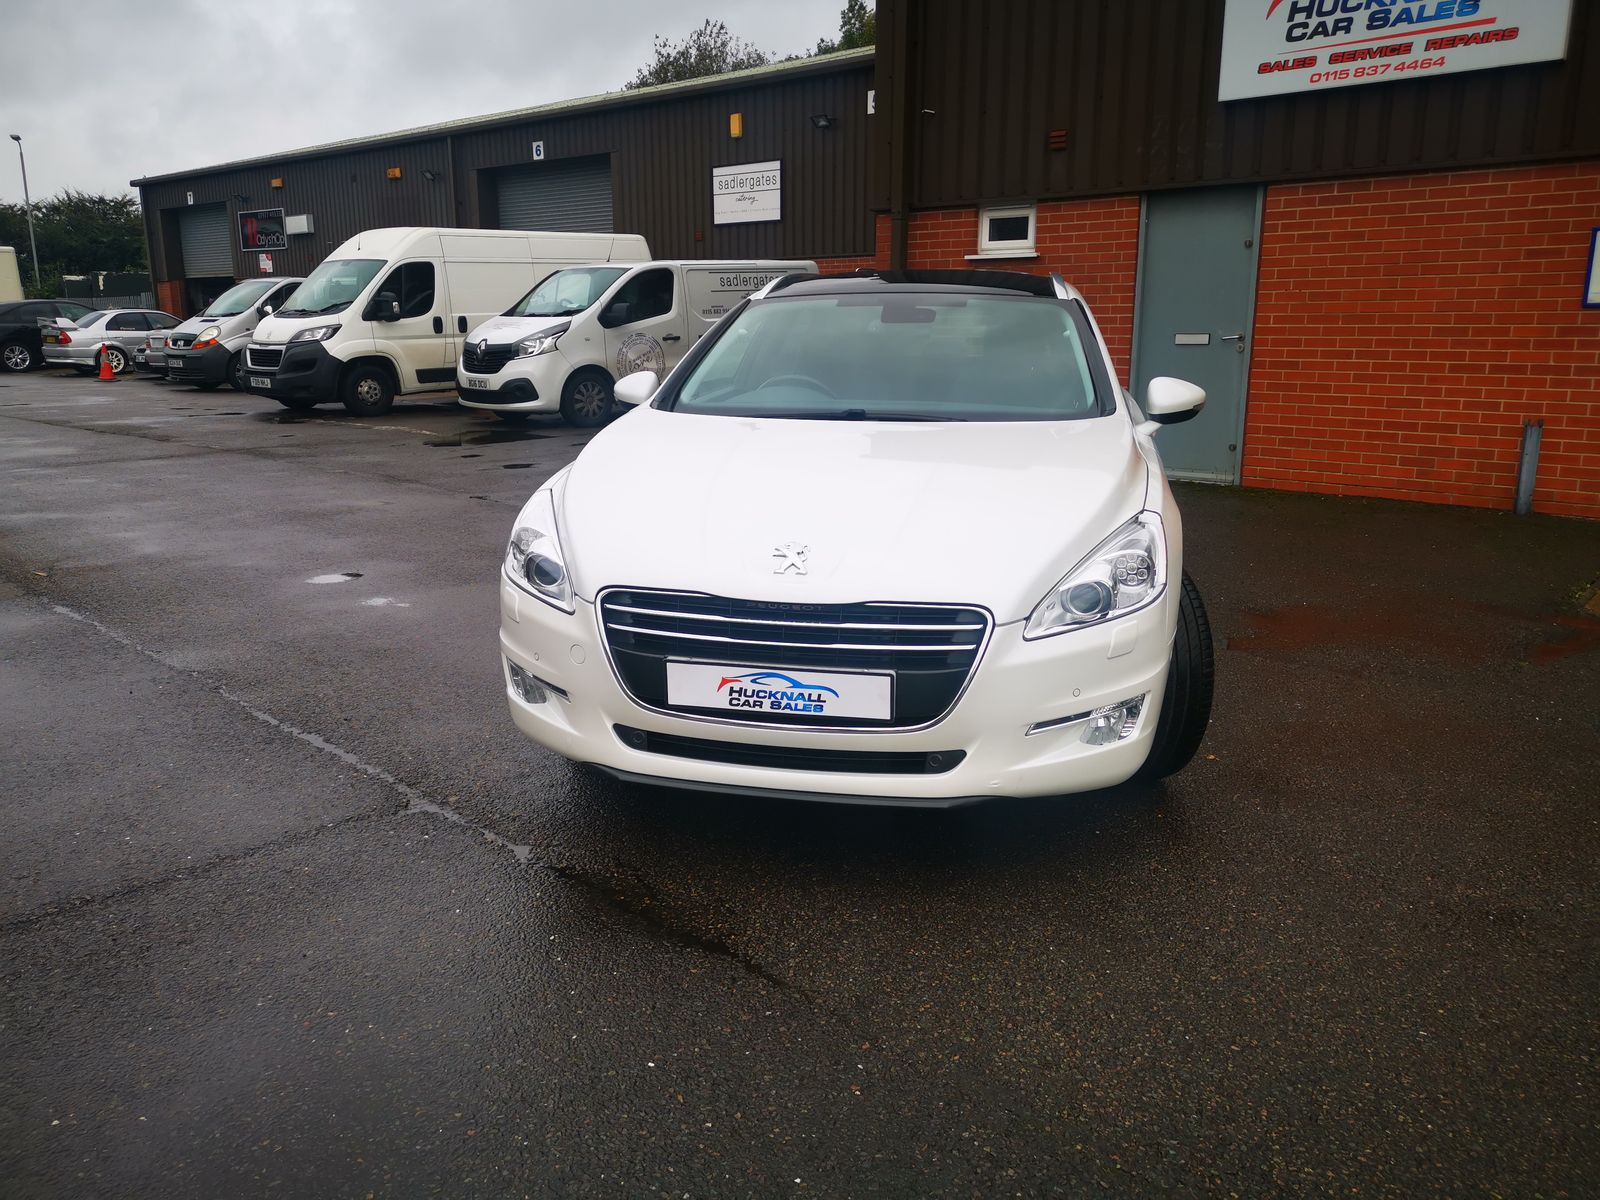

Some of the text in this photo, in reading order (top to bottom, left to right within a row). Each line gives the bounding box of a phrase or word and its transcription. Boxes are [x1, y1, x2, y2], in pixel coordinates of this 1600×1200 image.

[1286, 0, 1428, 23] HUCK
[1285, 0, 1480, 43] CAR SALES
[1258, 27, 1519, 75] SALES SERVICE REPAIRS
[1309, 56, 1446, 84] 0115 837 4464
[535, 144, 542, 157] 6
[718, 173, 778, 190] sadlergates
[719, 274, 780, 289] sadlergat
[746, 602, 823, 611] PEUGEOT
[728, 686, 827, 704] HUCKNALL
[728, 698, 824, 713] CAR SALES
